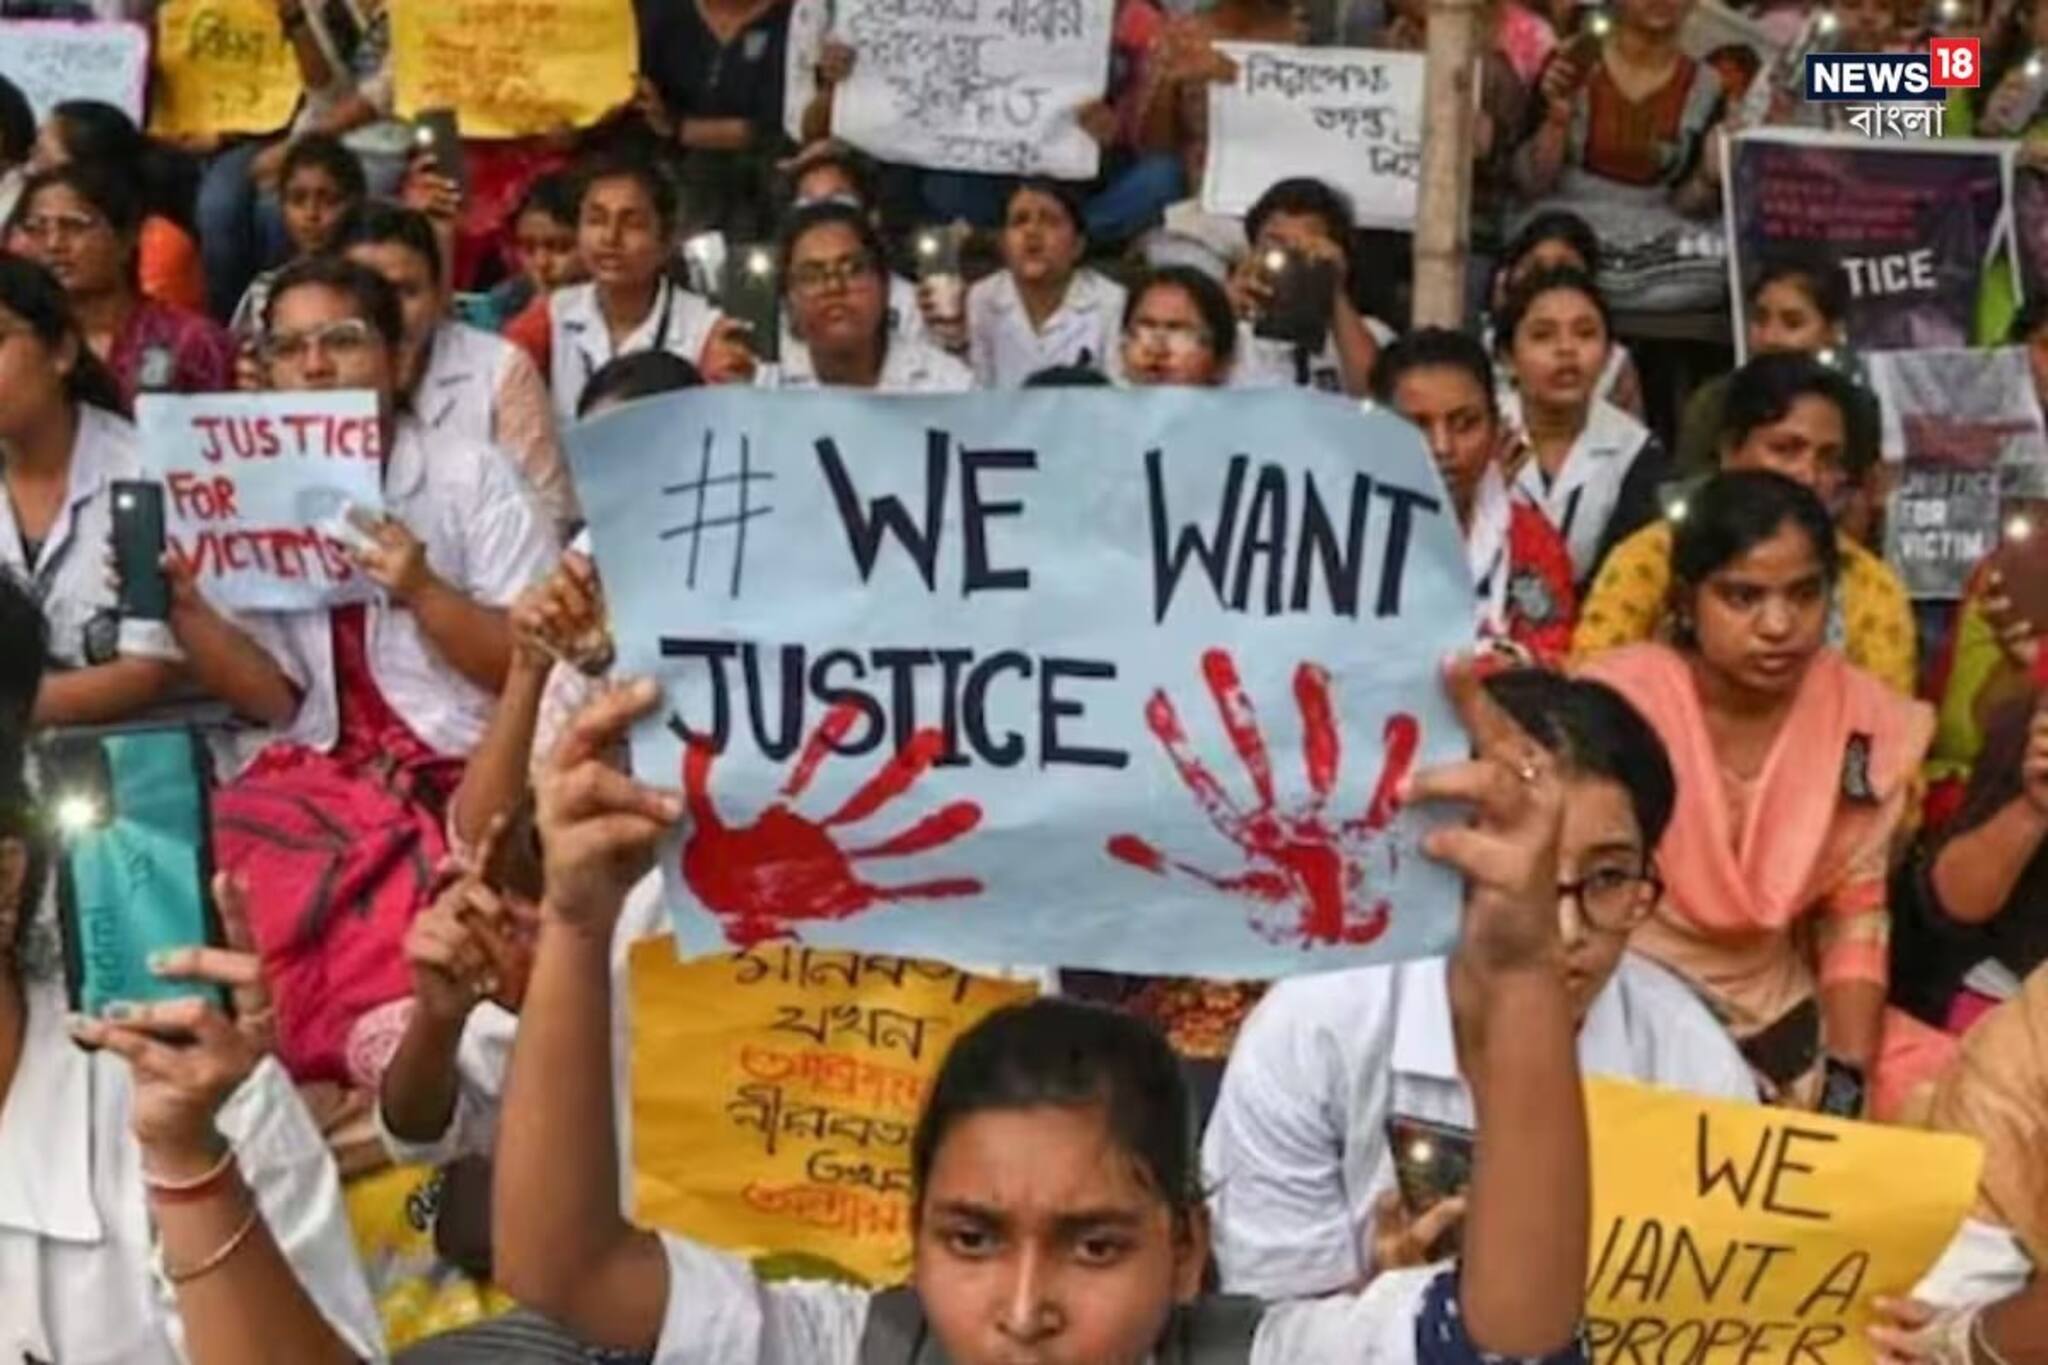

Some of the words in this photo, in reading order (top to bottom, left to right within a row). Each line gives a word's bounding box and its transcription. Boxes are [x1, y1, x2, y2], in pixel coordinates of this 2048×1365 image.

[1842, 249, 1940, 297] TICE
[192, 415, 382, 462] JUSTICE
[166, 472, 238, 520] FOR
[814, 428, 1039, 596] WE
[1145, 449, 1441, 624] WANT
[660, 637, 1129, 770] JUSTICE
[725, 1083, 911, 1156] নীরবত
[1697, 1112, 1838, 1220] WE
[1794, 1250, 1869, 1318] A
